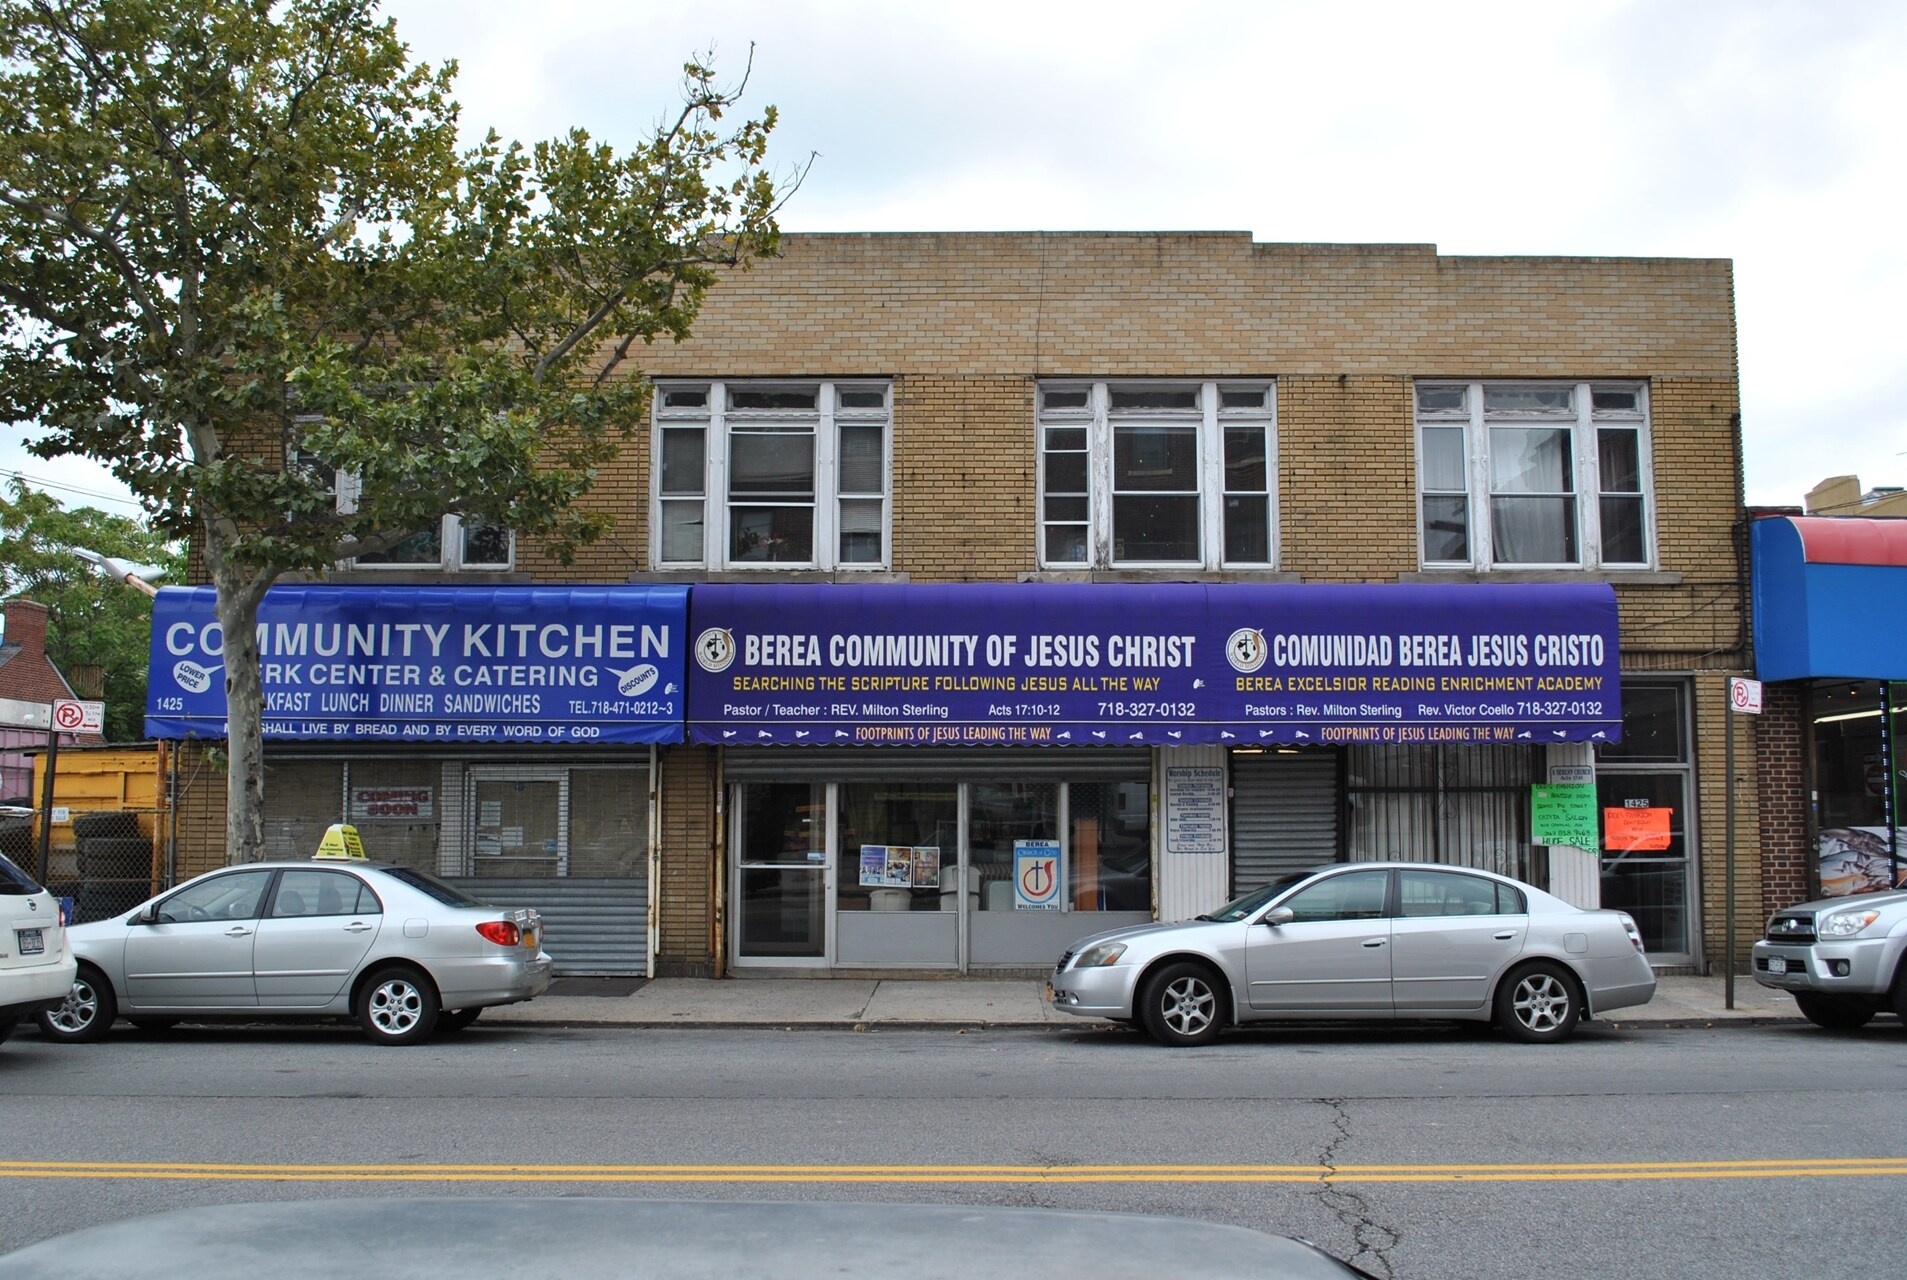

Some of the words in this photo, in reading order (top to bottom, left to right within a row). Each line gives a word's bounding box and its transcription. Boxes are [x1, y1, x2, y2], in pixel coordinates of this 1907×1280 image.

[463, 623, 670, 658] KITCHEN
[745, 634, 822, 666] BEREA
[829, 634, 979, 667] COMMUNITY
[986, 634, 1017, 667] OF
[1024, 634, 1100, 668] JESUS
[1107, 634, 1196, 668] CHRIST
[1273, 634, 1393, 667] COMUNIDAD
[1399, 634, 1463, 667] BEREA
[1467, 634, 1529, 667] JESUS
[1534, 634, 1604, 667] CRISTO
[180, 663, 206, 681] LOWER
[309, 663, 421, 685] CENTER
[428, 665, 447, 686] &
[454, 665, 598, 687] CATERING
[177, 673, 200, 689] PRICE
[620, 667, 656, 694] DISCOUNTS
[733, 676, 814, 691] SEARCHING
[819, 676, 845, 691] THE
[851, 676, 930, 691] SCRIPTURE
[935, 676, 1015, 691] FOLLOWING
[1021, 676, 1067, 691] JESUS
[1073, 676, 1098, 691] ALL
[1101, 676, 1128, 691] THE
[1132, 677, 1161, 691] WAY
[1236, 676, 1283, 691] BEREA
[1288, 676, 1366, 691] EXCELSIOR
[1372, 676, 1435, 691] READING
[1441, 676, 1533, 691] ENRICHMENT
[1537, 676, 1603, 691] ACADEMY
[157, 697, 183, 711] 1425
[321, 692, 369, 712] LUNCH
[380, 693, 434, 713] DINNER
[444, 694, 541, 714] SANDWICHES
[724, 704, 762, 716] Pastor
[773, 704, 821, 716] Teacher
[831, 704, 859, 716] REV.
[862, 703, 899, 716] Milton
[902, 703, 949, 719] Sterling
[988, 704, 1012, 716] Acts
[1016, 704, 1061, 716] 17:10-12
[1098, 702, 1196, 717] 718-327-0132
[1245, 704, 1287, 716] Pastors
[1297, 704, 1320, 716] Rev.
[1323, 704, 1356, 716] Milton
[1360, 703, 1402, 719] Sterling
[1418, 704, 1442, 716] Rev.
[1444, 704, 1476, 716] Victor
[1479, 704, 1515, 716] Coello
[1517, 702, 1603, 716] 718-327-0132
[302, 723, 328, 734] LIVE
[333, 723, 350, 735] BY
[356, 724, 397, 735] BREAD
[402, 724, 430, 735] AND
[435, 725, 451, 736] BY
[457, 725, 497, 736] EVERY
[502, 725, 542, 737] WORD
[547, 726, 566, 737] OF
[571, 726, 600, 738] GOD
[855, 726, 915, 741] FOOTPRINTS
[917, 726, 930, 741] OF
[932, 726, 961, 743] JESUS
[963, 727, 1006, 741] LEADING
[1008, 727, 1027, 740] THE
[1030, 727, 1052, 740] WAY
[1321, 726, 1380, 741] FOOTPRINTS
[1383, 727, 1395, 741] OF
[1398, 726, 1426, 744] JESUS
[1429, 726, 1470, 741] LEADING
[1472, 726, 1491, 740] THE
[1493, 726, 1515, 740] WAY
[1168, 769, 1192, 778] Worship
[1194, 769, 1221, 777] Schedule
[1625, 799, 1649, 807] 1425
